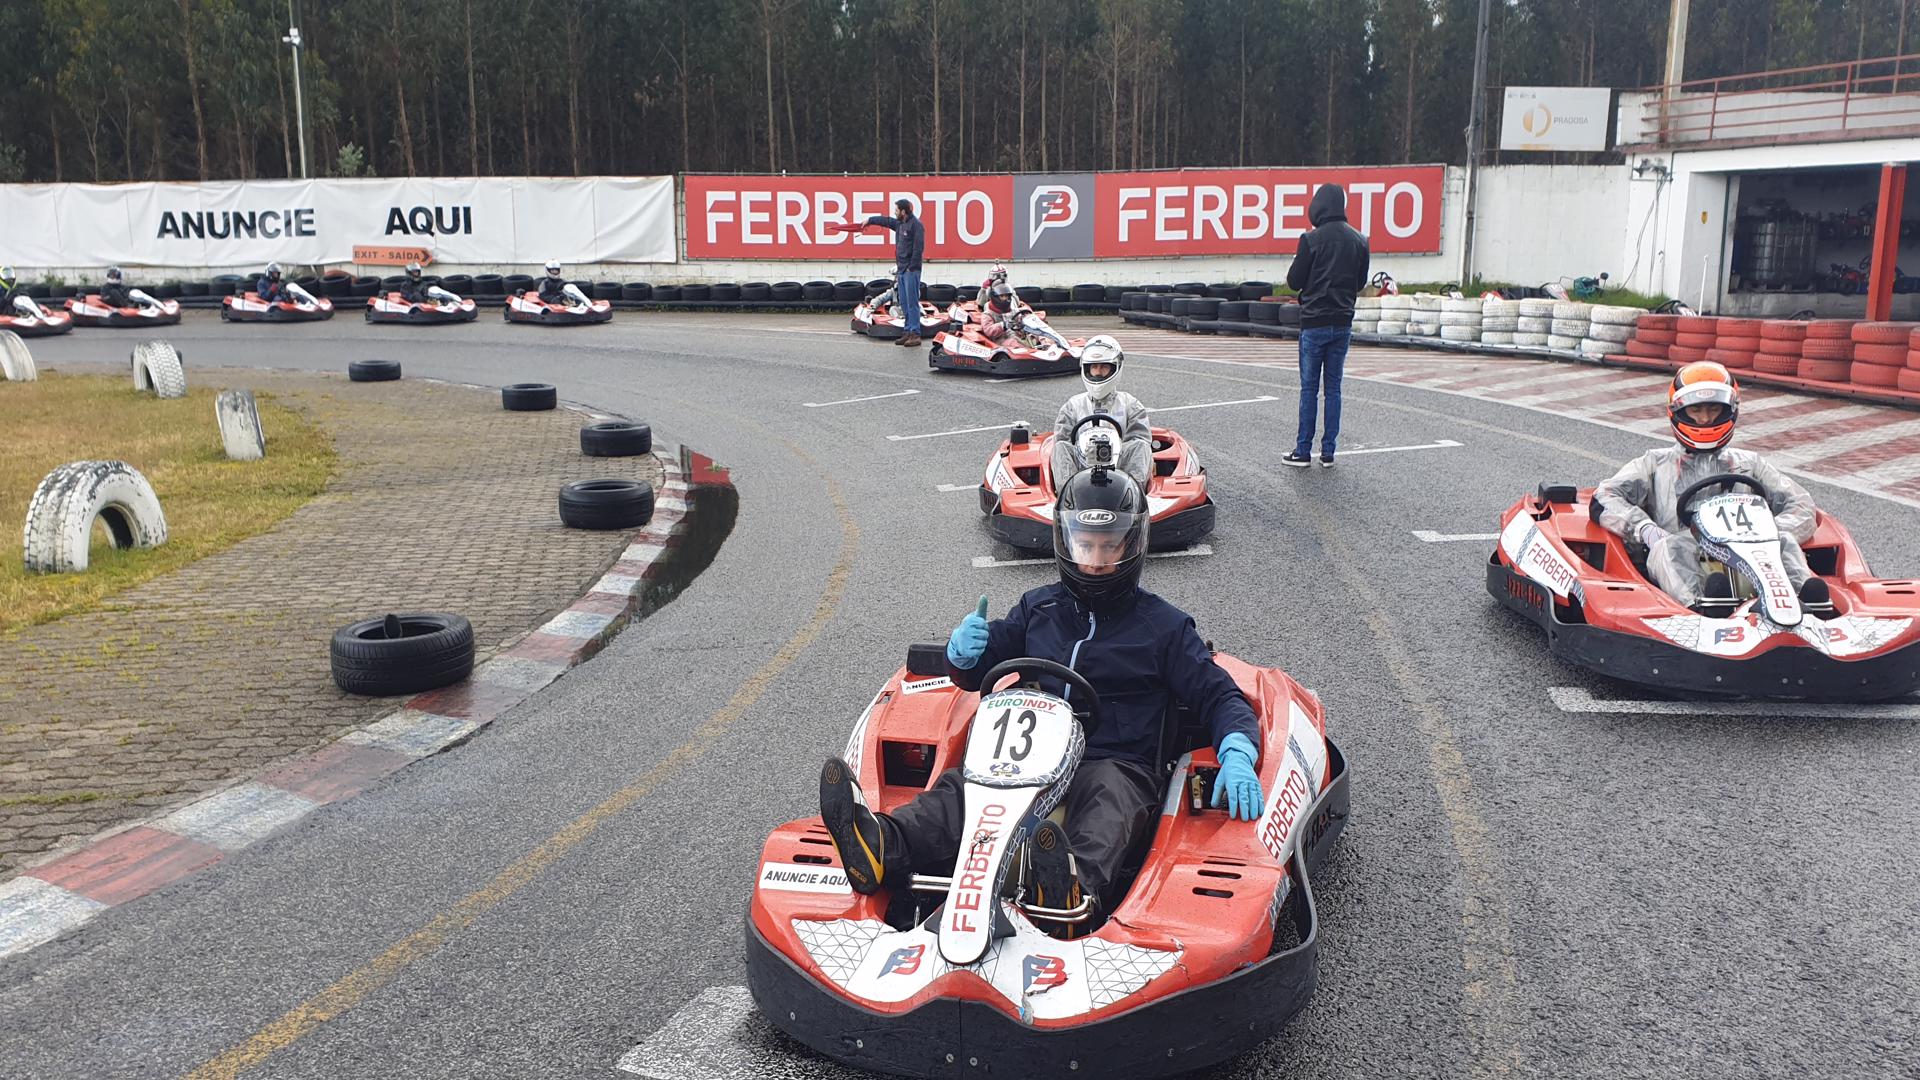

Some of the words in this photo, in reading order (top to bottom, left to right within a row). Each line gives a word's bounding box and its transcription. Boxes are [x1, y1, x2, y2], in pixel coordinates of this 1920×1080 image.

[156, 208, 317, 240] ANUNCIE
[384, 206, 473, 237] AQUI
[1118, 181, 1423, 242] FERBETO
[354, 250, 379, 259] EXIT
[388, 250, 420, 260] SAÍDA
[1709, 496, 1756, 507] EUROIND
[1082, 513, 1111, 522] HJC
[1715, 503, 1753, 531] 14
[1528, 542, 1573, 590] FERBERT
[906, 679, 946, 690] ANUNCIE
[987, 698, 1057, 711] EUROINDY
[993, 708, 1037, 761] 13
[1263, 769, 1306, 860] ERBERTO
[764, 870, 819, 884] ANUNCIE
[819, 874, 849, 887] AQUI
[952, 804, 1006, 932] FERBERTO
